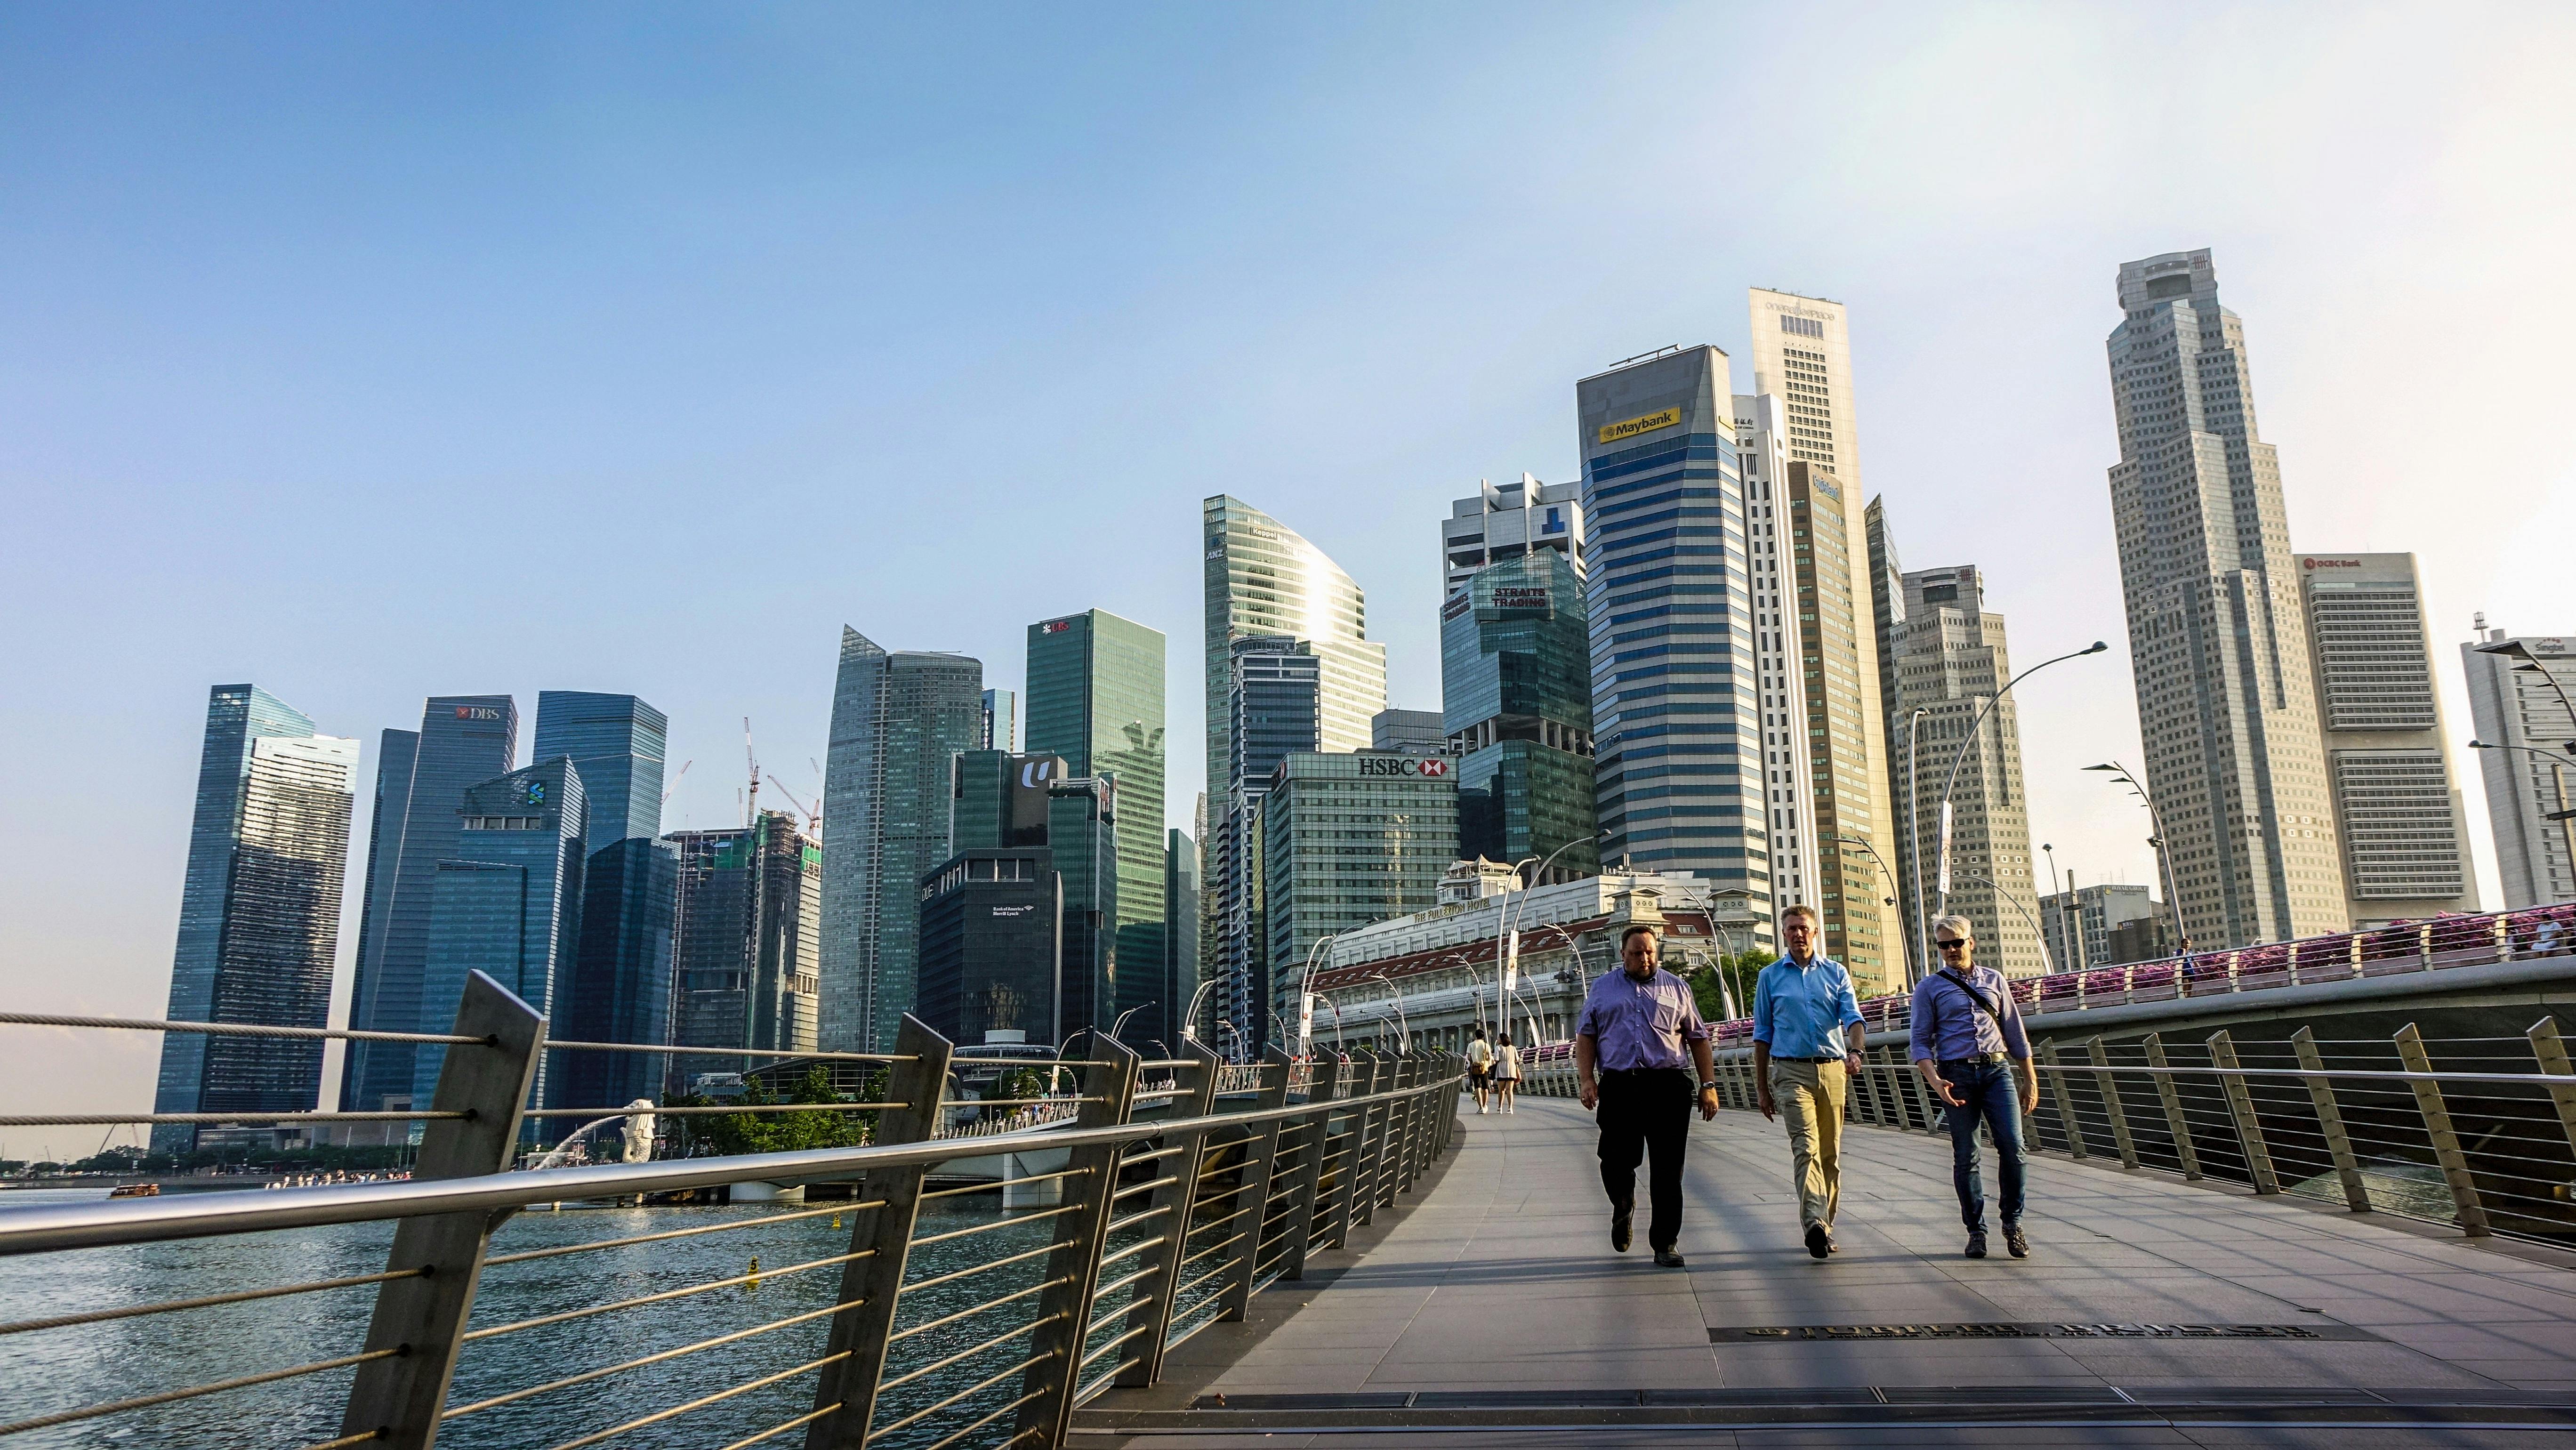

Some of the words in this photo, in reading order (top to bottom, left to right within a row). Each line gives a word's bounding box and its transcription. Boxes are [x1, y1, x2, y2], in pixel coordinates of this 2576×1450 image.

[1616, 412, 1672, 435] Maybank
[1253, 528, 1276, 538] Keppel
[1206, 549, 1224, 560] ANZ
[2341, 559, 2361, 567] Bank
[1495, 588, 1546, 596] STRAITS
[1492, 598, 1546, 607] TRADING
[1051, 621, 1070, 632] UBS
[2535, 642, 2565, 653] Singtel
[471, 708, 499, 719] DBS
[1359, 758, 1416, 776] HSBC
[1413, 913, 1426, 923] THE
[1428, 903, 1465, 921] FULLERTON
[1467, 897, 1491, 911] HOTEL
[750, 1259, 757, 1270] 5
[1797, 1325, 2024, 1335] JUBILEE
[2054, 1324, 2312, 1334] BRIDGE
